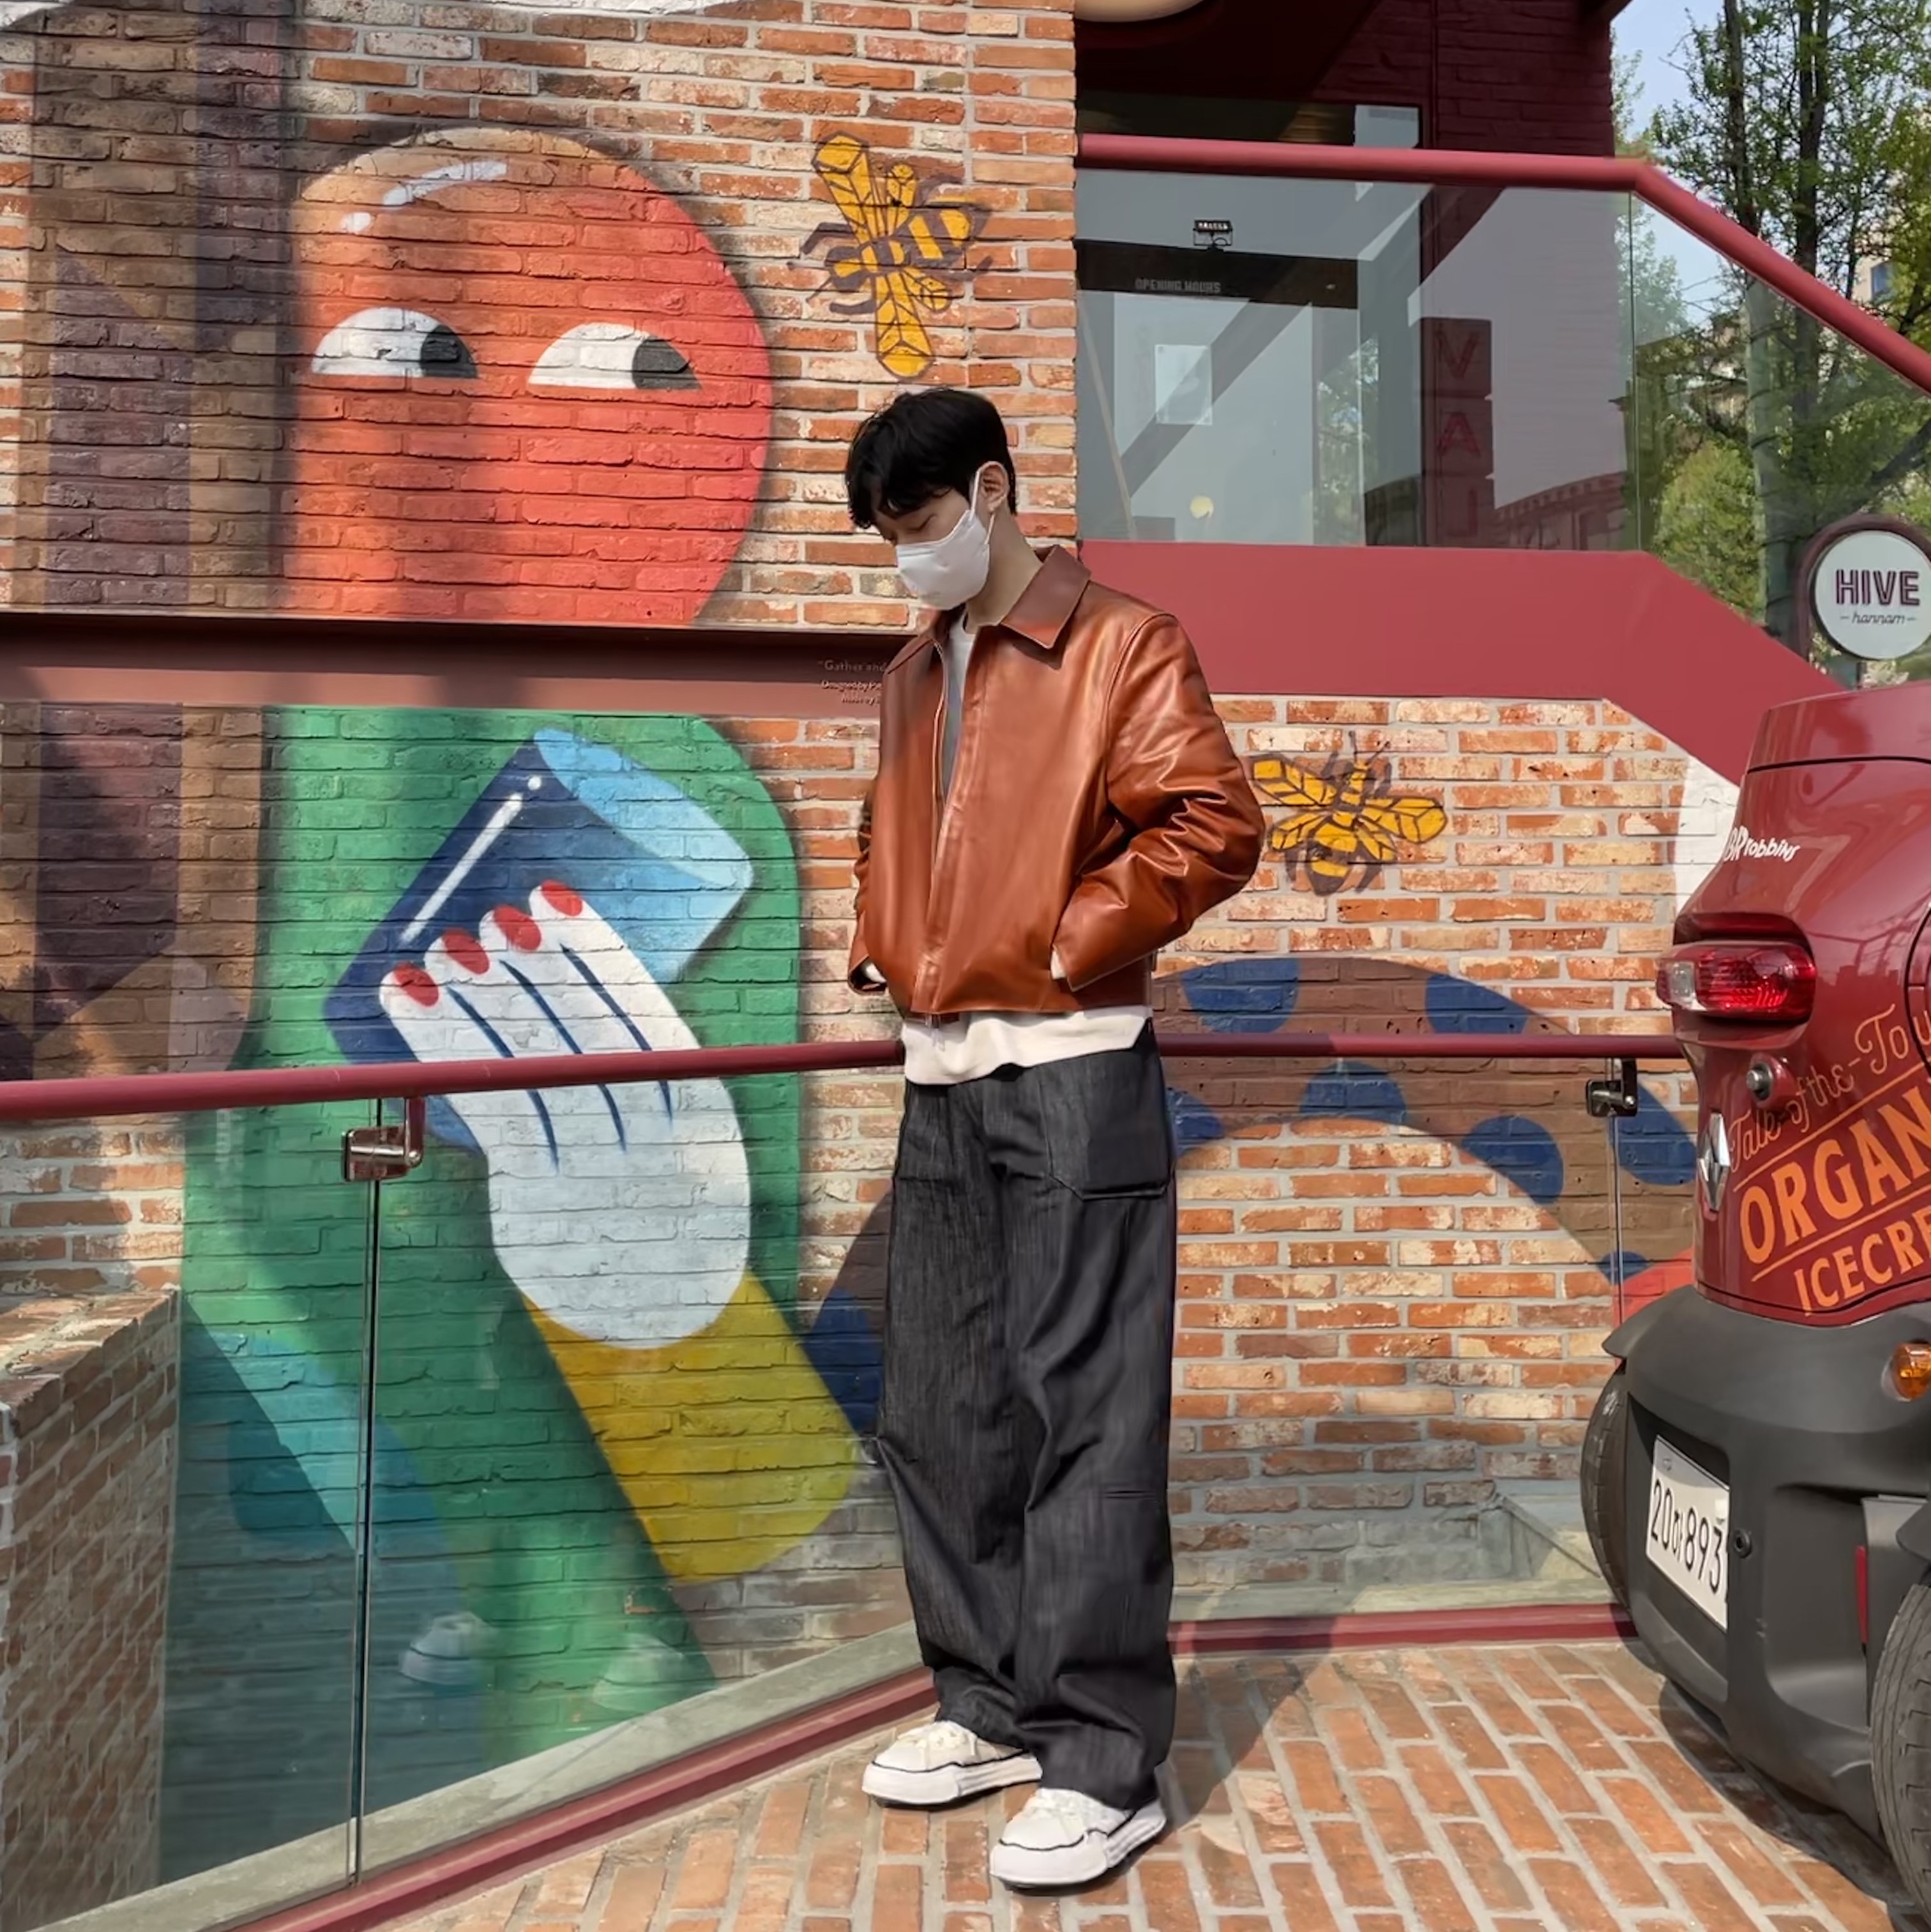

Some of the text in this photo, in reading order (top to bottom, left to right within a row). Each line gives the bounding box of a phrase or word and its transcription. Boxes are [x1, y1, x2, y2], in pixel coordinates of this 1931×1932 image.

[1835, 569, 1920, 606] HIVE
[1852, 611, 1905, 625] hannam
[1740, 1086, 1931, 1265] ORGAN
